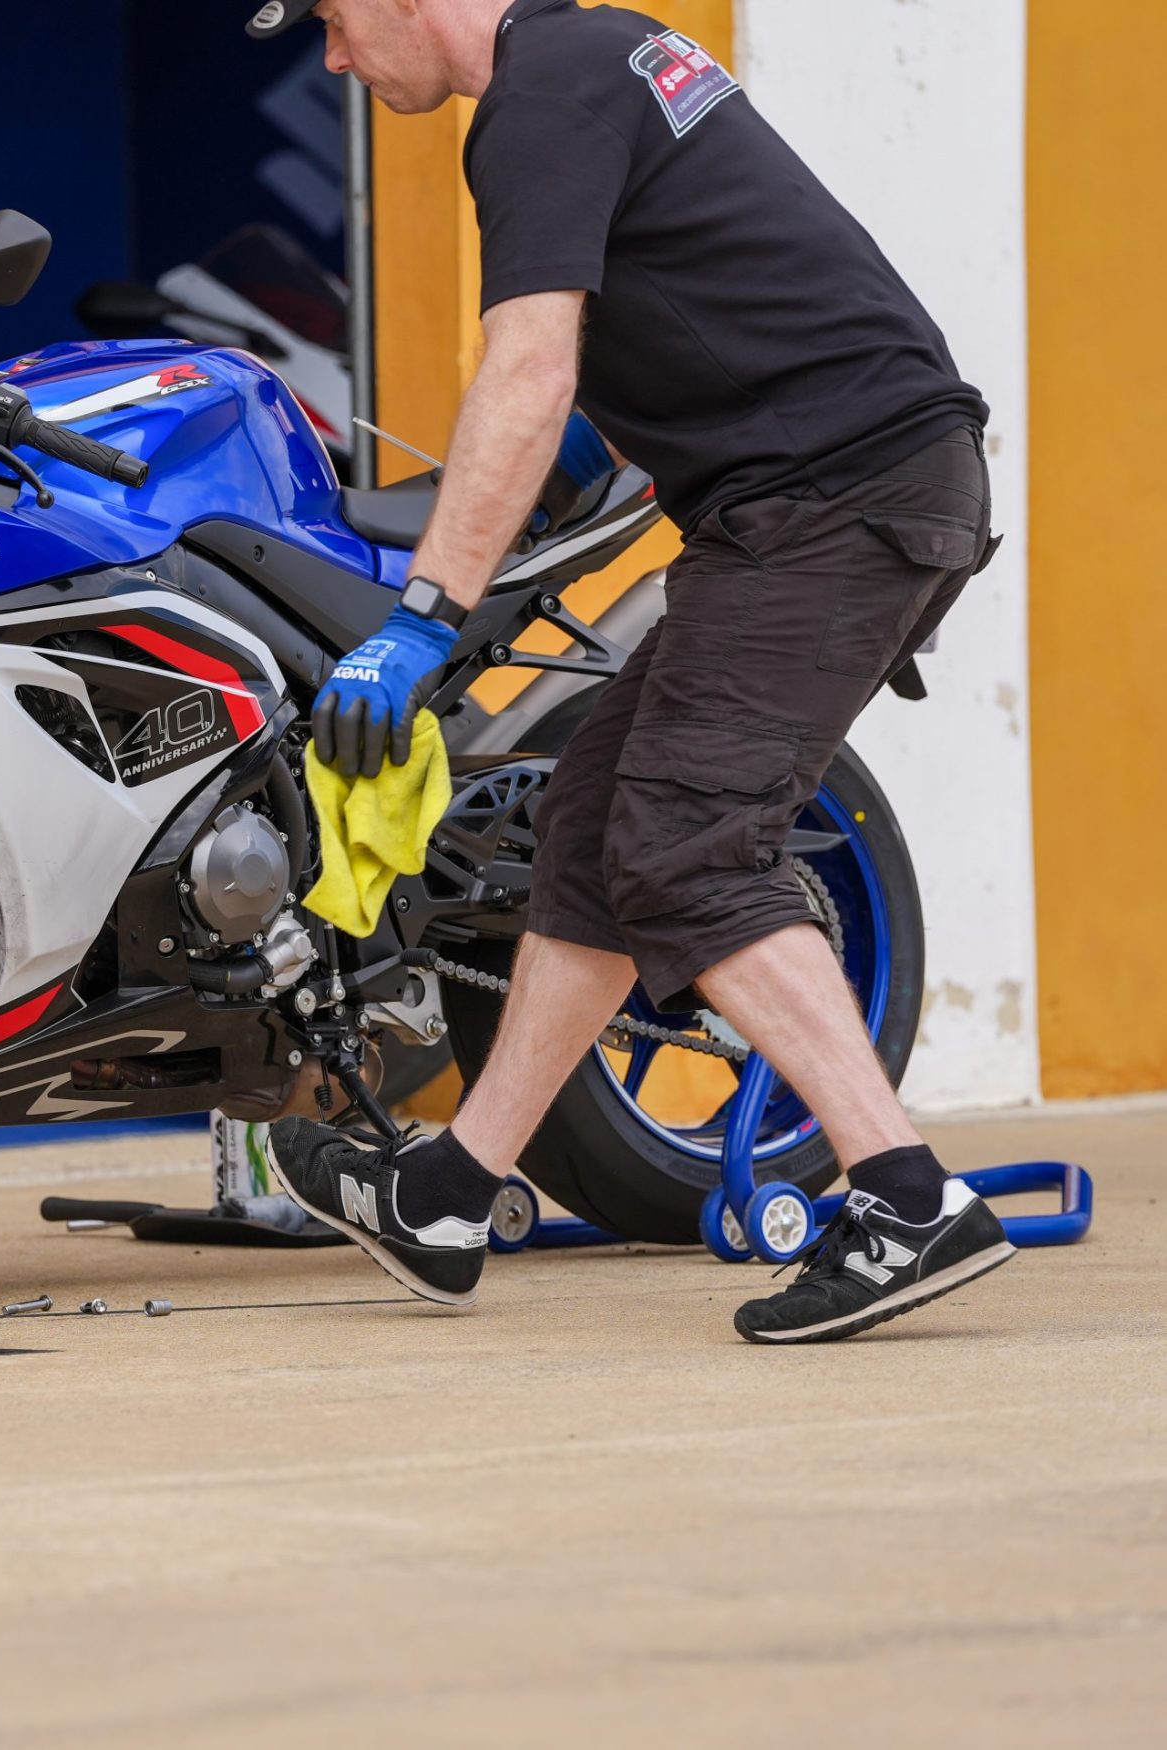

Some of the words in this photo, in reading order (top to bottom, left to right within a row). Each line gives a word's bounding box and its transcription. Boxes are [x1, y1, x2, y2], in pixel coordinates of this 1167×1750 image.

[331, 665, 380, 683] uvex
[122, 733, 214, 778] ANNIVERSARY
[339, 1173, 381, 1233] N
